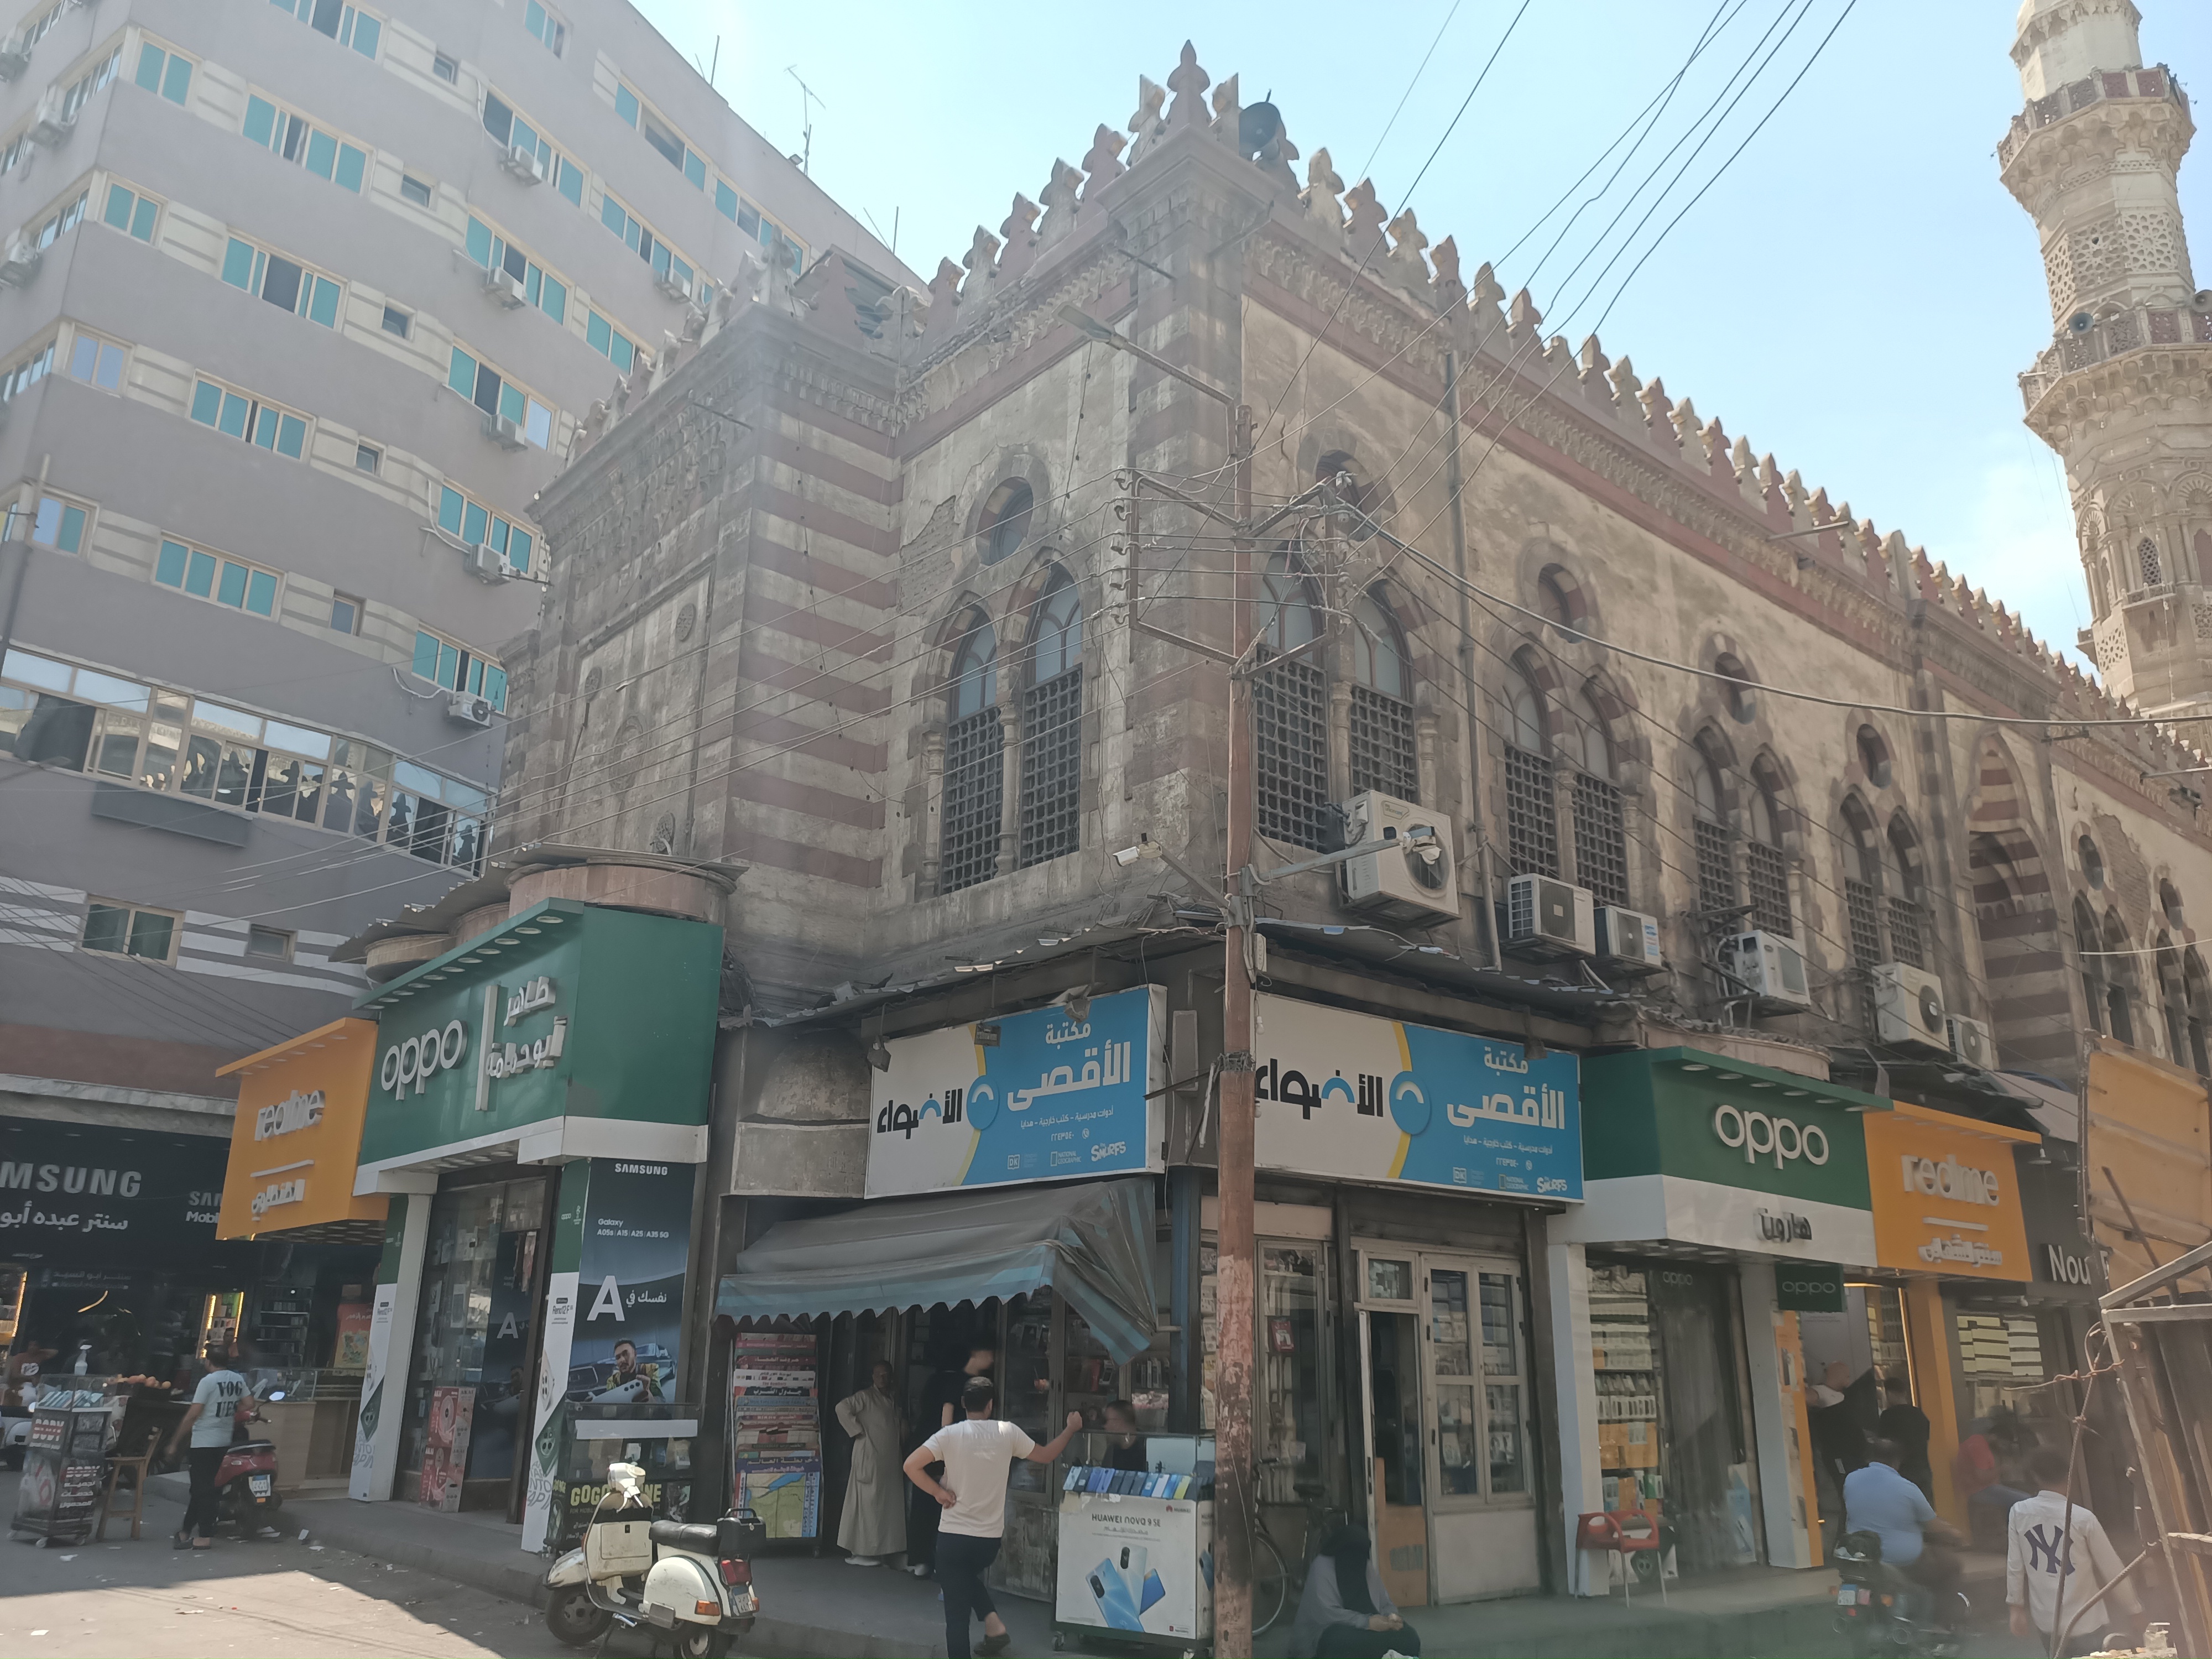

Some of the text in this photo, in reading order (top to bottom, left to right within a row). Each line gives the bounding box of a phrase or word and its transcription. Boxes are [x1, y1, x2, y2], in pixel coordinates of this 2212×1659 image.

[504, 976, 555, 1027] طاهر
[1045, 1021, 1092, 1049] مكتبة
[381, 1019, 466, 1100] oppo
[1483, 1046, 1529, 1075] مكتبة
[1006, 1039, 1131, 1112] الأقصى
[1056, 1114, 1070, 1125] كتب
[1074, 1112, 1097, 1122] مدرسية
[1447, 1083, 1566, 1130] الأقصى
[1714, 1104, 1830, 1170] oppo
[0, 1161, 142, 1197] MSUNG
[615, 1163, 668, 1176] SAMSUNG
[33, 1211, 79, 1230] عبده
[82, 1213, 128, 1233] سنتر
[598, 1218, 624, 1228] Galaxy
[1662, 1271, 1693, 1286] oppo
[2048, 1244, 2092, 1285] Nou
[587, 1275, 667, 1321] نفسك في A
[1782, 1280, 1837, 1296] oppo
[1092, 1513, 1122, 1524] HUAWEI
[1147, 1517, 1152, 1526] 9
[1153, 1519, 1161, 1527] SE
